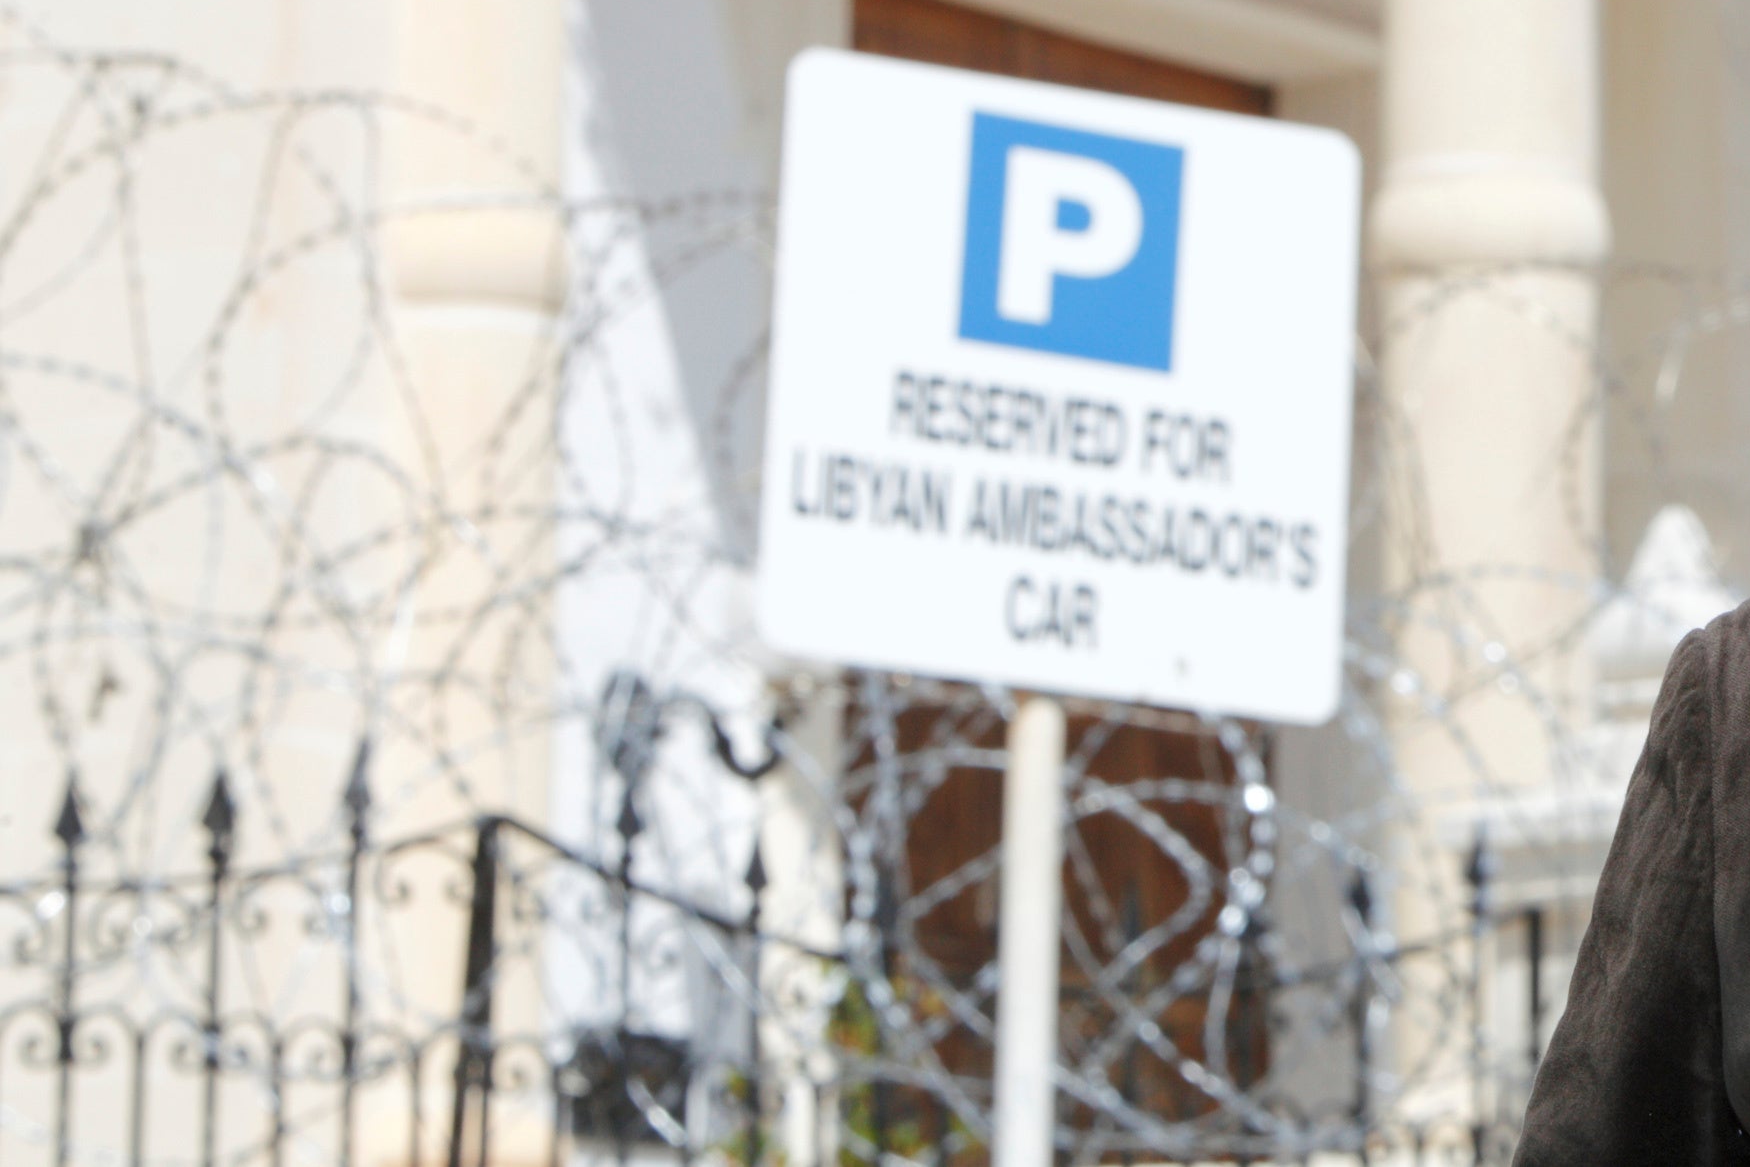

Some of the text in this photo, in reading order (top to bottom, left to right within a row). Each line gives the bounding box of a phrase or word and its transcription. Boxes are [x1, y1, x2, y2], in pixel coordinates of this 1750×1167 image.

[996, 144, 1143, 325] P
[893, 371, 1232, 483] RESERVED FOR
[790, 450, 1318, 589] LIBYAN AMBASSADOR'S
[1004, 574, 1100, 649] CAR
